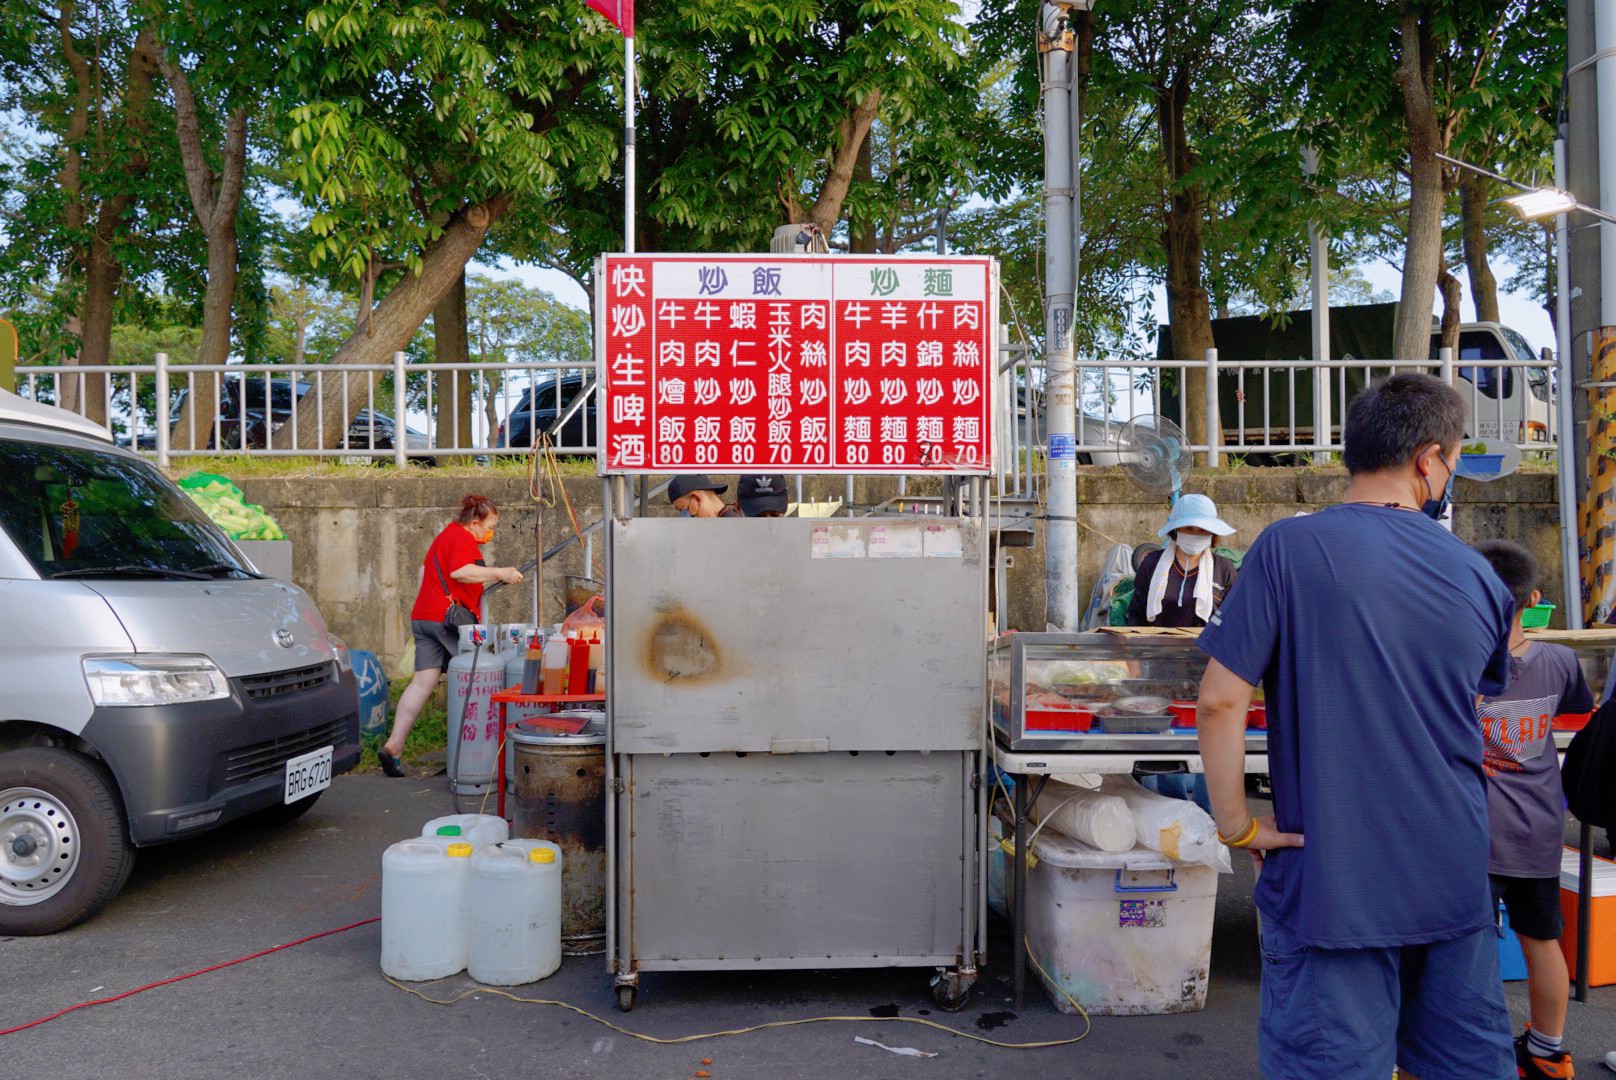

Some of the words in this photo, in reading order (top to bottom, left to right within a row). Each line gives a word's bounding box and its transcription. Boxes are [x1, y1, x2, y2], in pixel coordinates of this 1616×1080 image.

[698, 266, 782, 296] 炒飯
[869, 267, 953, 297] 炒麵
[659, 302, 687, 443] 牛肉燴飯
[694, 302, 722, 443] 牛肉炒飯
[729, 302, 757, 443] 蝦仁炒飯
[767, 302, 792, 443] 玉米火腿炒飯
[800, 302, 828, 443] 肉絲炒飯
[844, 302, 872, 443] 牛肉炒麵
[880, 302, 908, 443] 羊肉炒麵
[916, 302, 944, 443] 什錦炒麵
[952, 302, 980, 443] 肉絲炒麵
[660, 444, 684, 465] 80
[695, 444, 719, 465] 80
[731, 444, 756, 465] 80
[769, 444, 793, 465] 70
[802, 444, 826, 465] 70
[846, 444, 870, 465] 80
[882, 444, 906, 465] 80
[954, 444, 978, 465] 70
